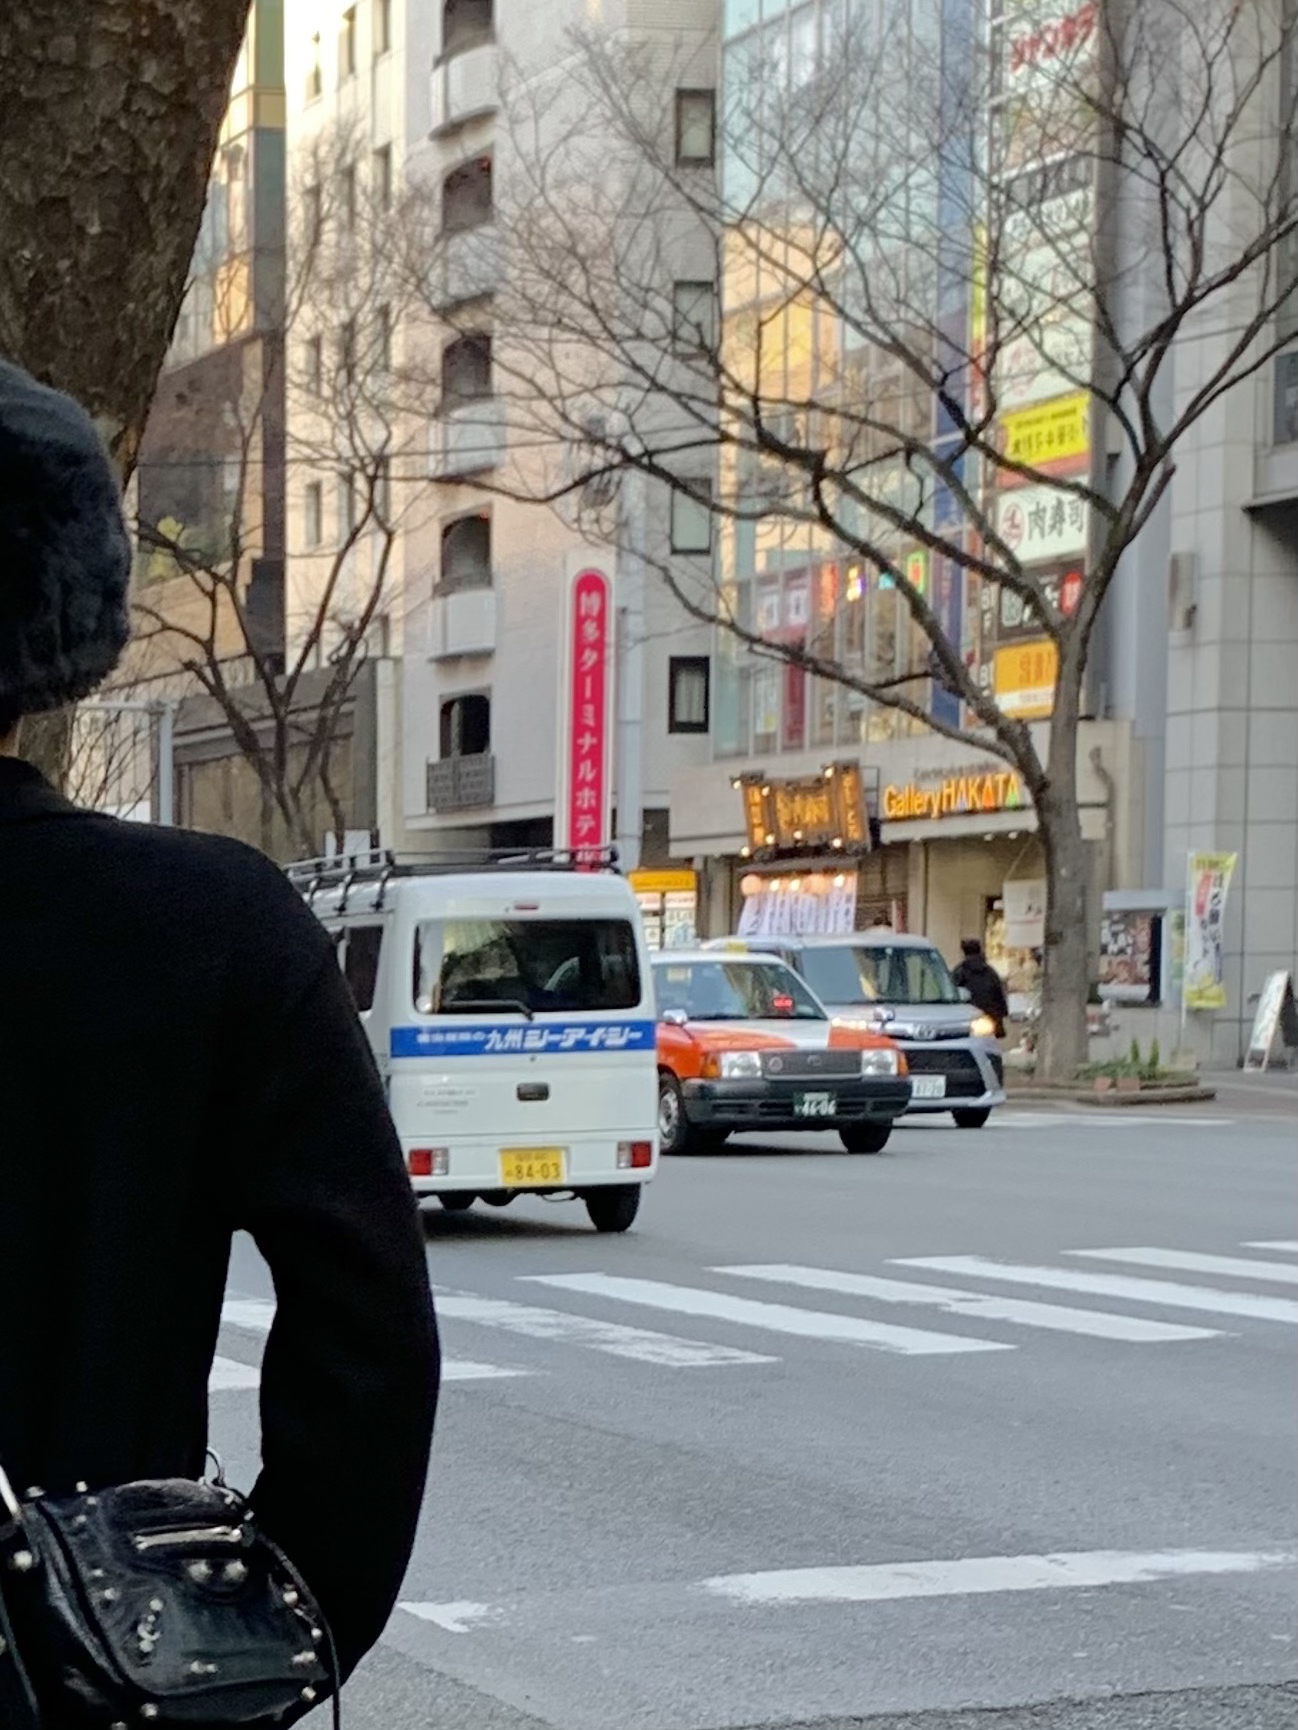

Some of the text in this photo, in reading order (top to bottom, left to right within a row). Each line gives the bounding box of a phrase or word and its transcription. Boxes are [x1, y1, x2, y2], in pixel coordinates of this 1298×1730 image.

[1028, 497, 1084, 540] 肉寿司
[575, 591, 602, 862] 博多ターミナルホテル
